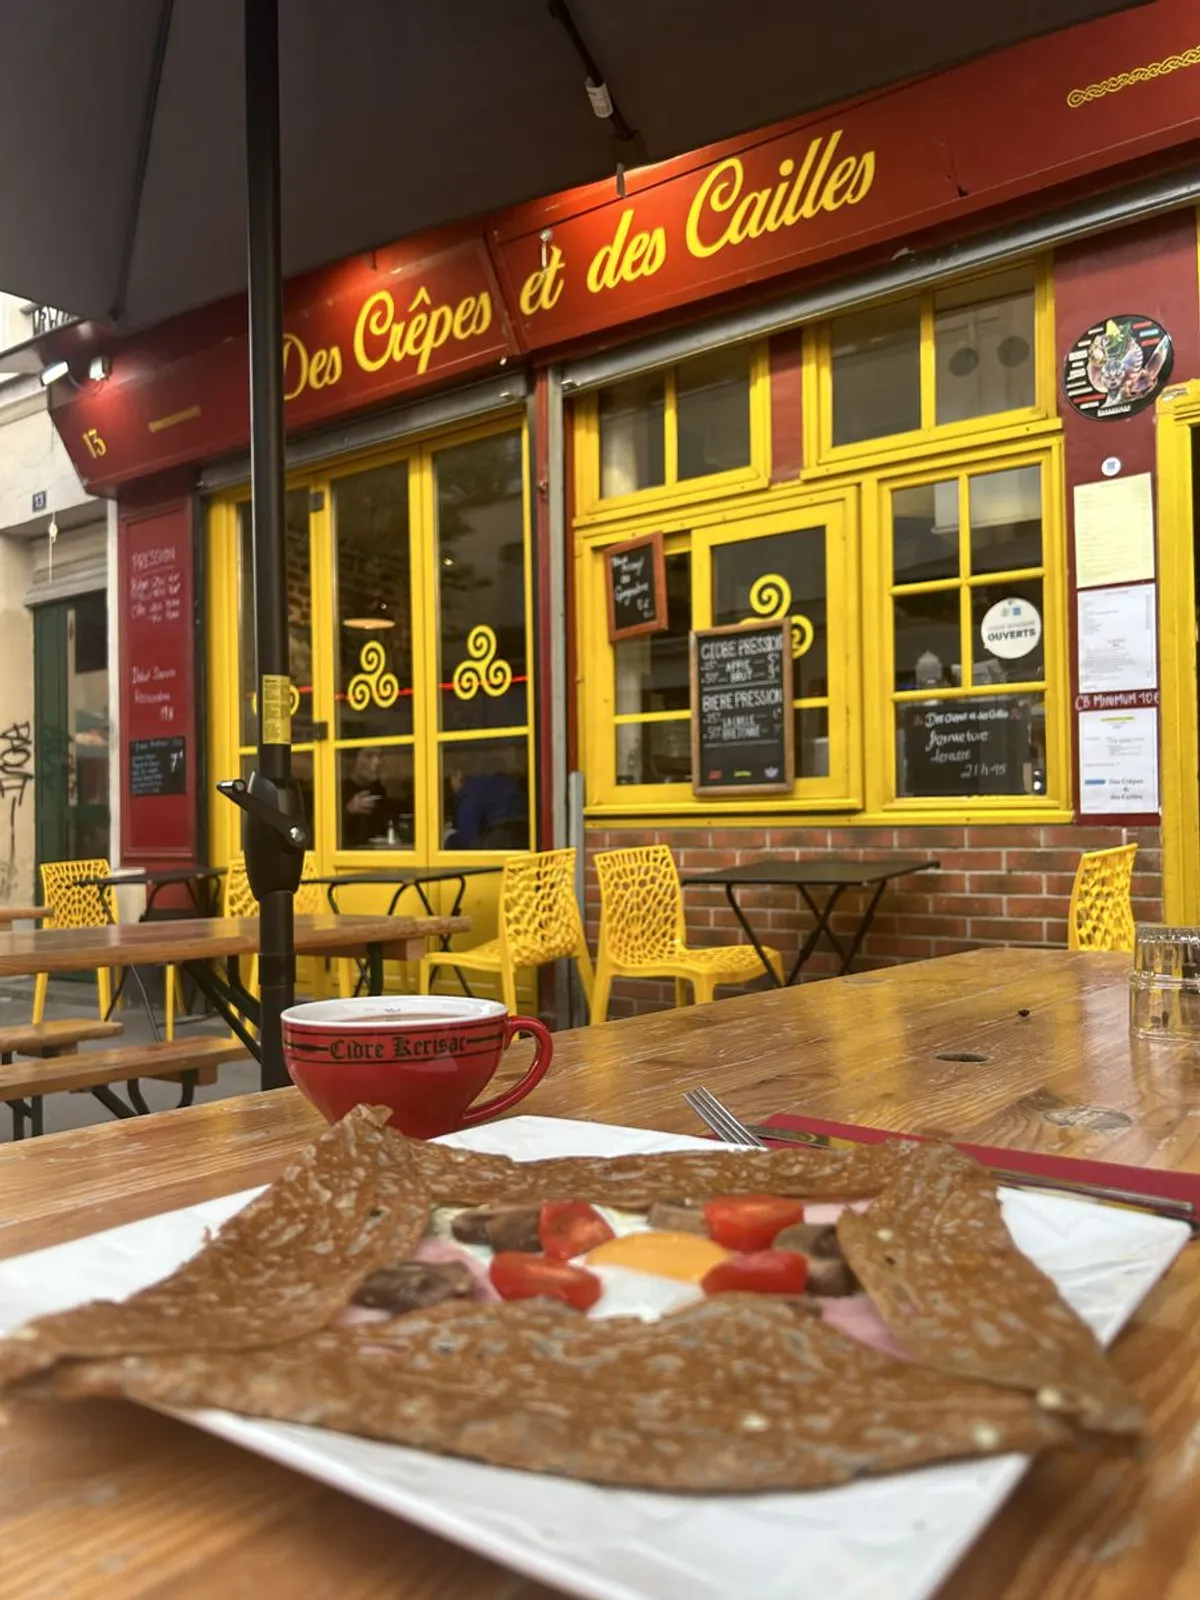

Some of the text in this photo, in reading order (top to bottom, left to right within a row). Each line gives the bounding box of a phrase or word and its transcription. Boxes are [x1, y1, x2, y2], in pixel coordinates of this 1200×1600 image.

[283, 129, 878, 401] Des Crêpes et des Cailles
[987, 628, 1037, 642] OUVERTS
[1075, 693, 1091, 711] CB
[329, 1039, 385, 1060] Cidre
